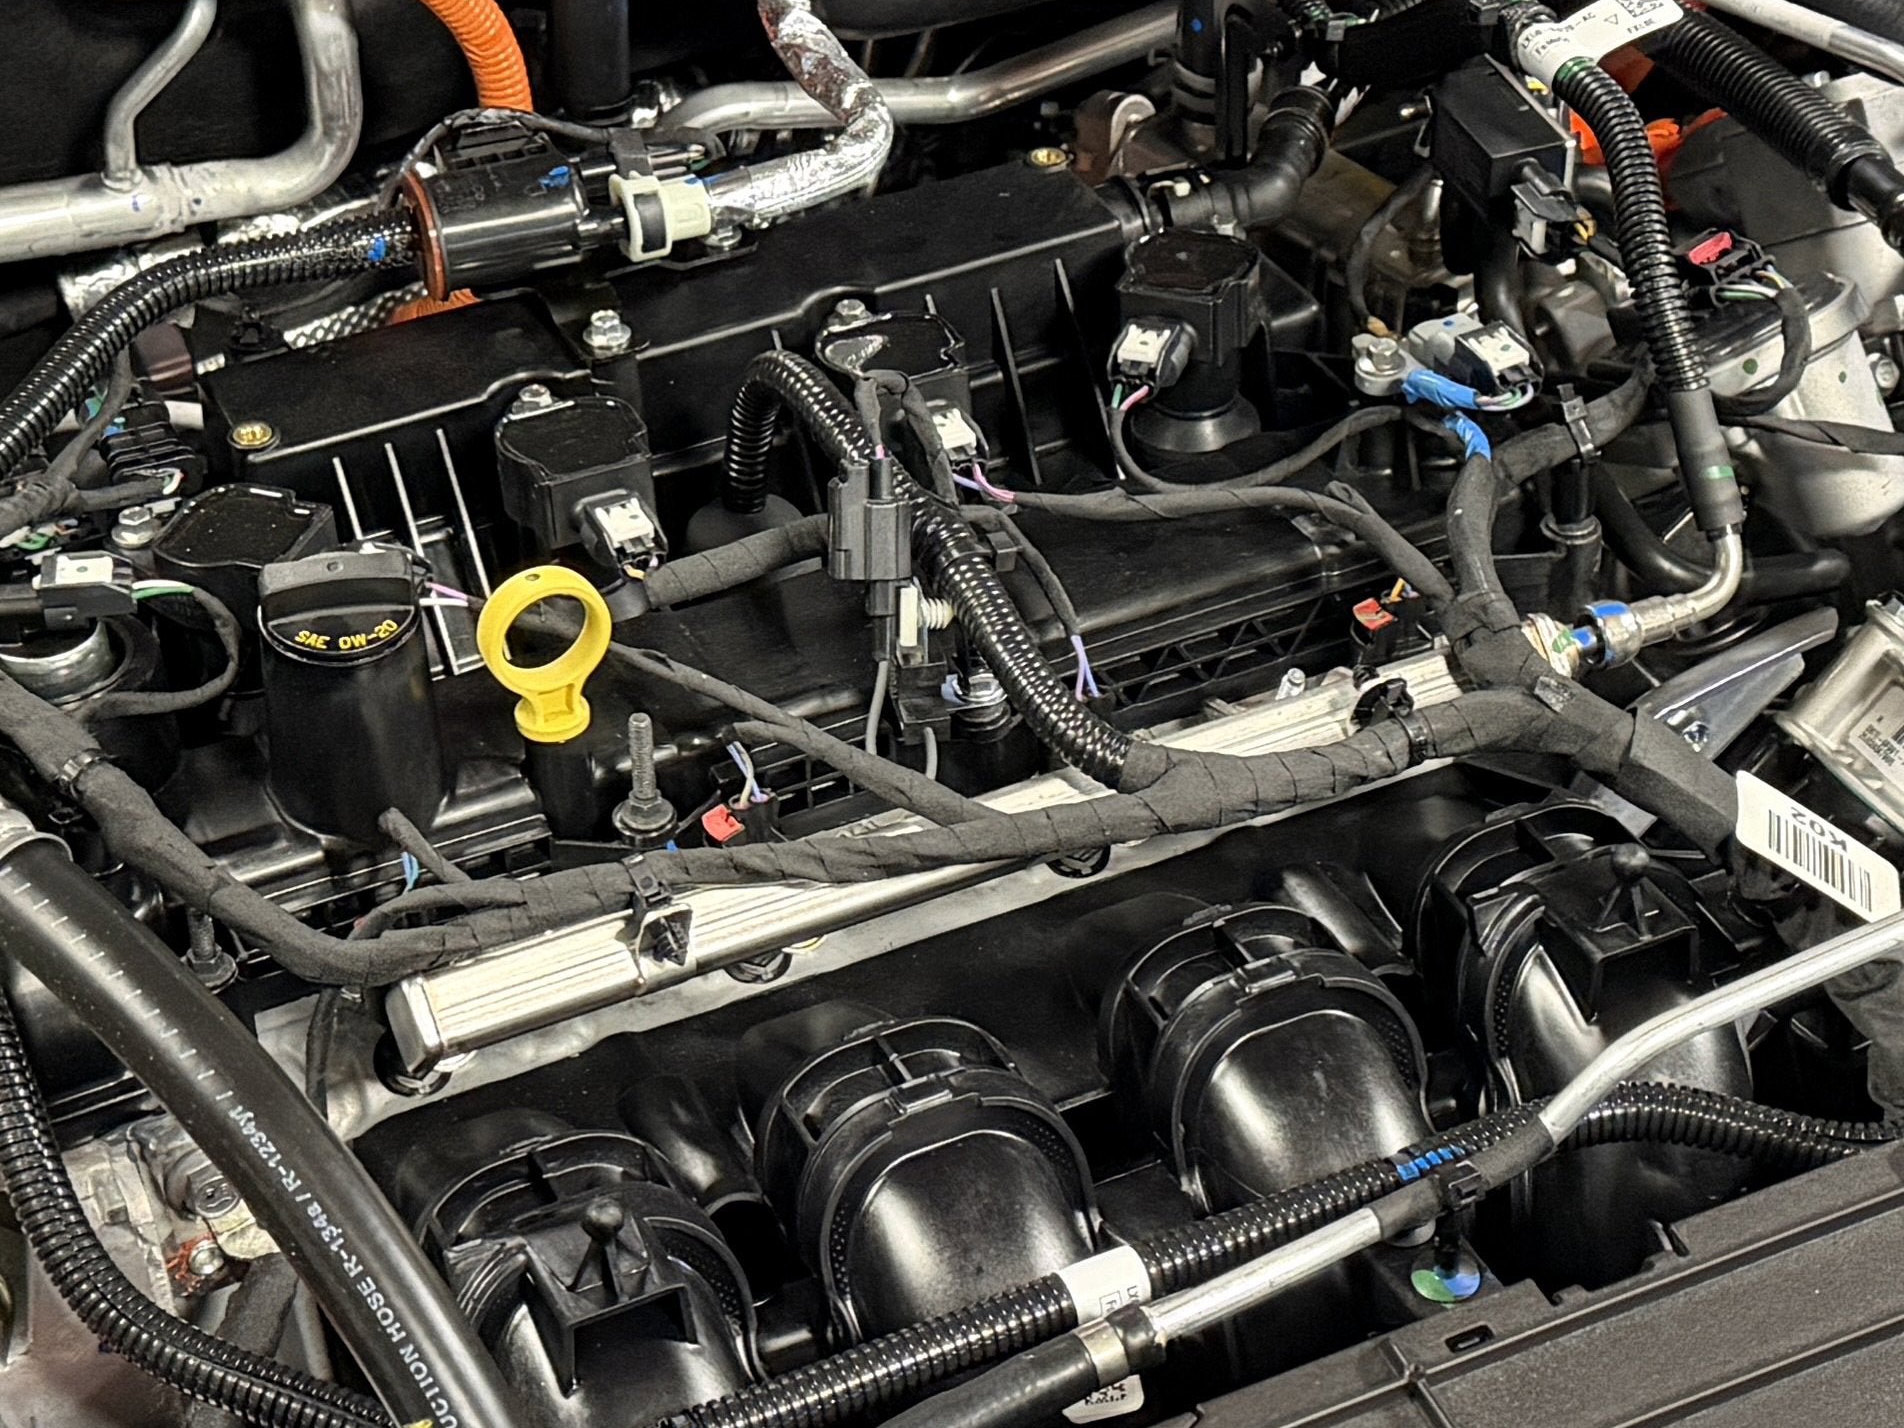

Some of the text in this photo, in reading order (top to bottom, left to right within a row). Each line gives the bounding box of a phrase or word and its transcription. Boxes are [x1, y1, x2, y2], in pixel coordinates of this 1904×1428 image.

[295, 630, 331, 649] SAE
[1791, 806, 1848, 853] K02
[356, 1276, 406, 1343] HOSE
